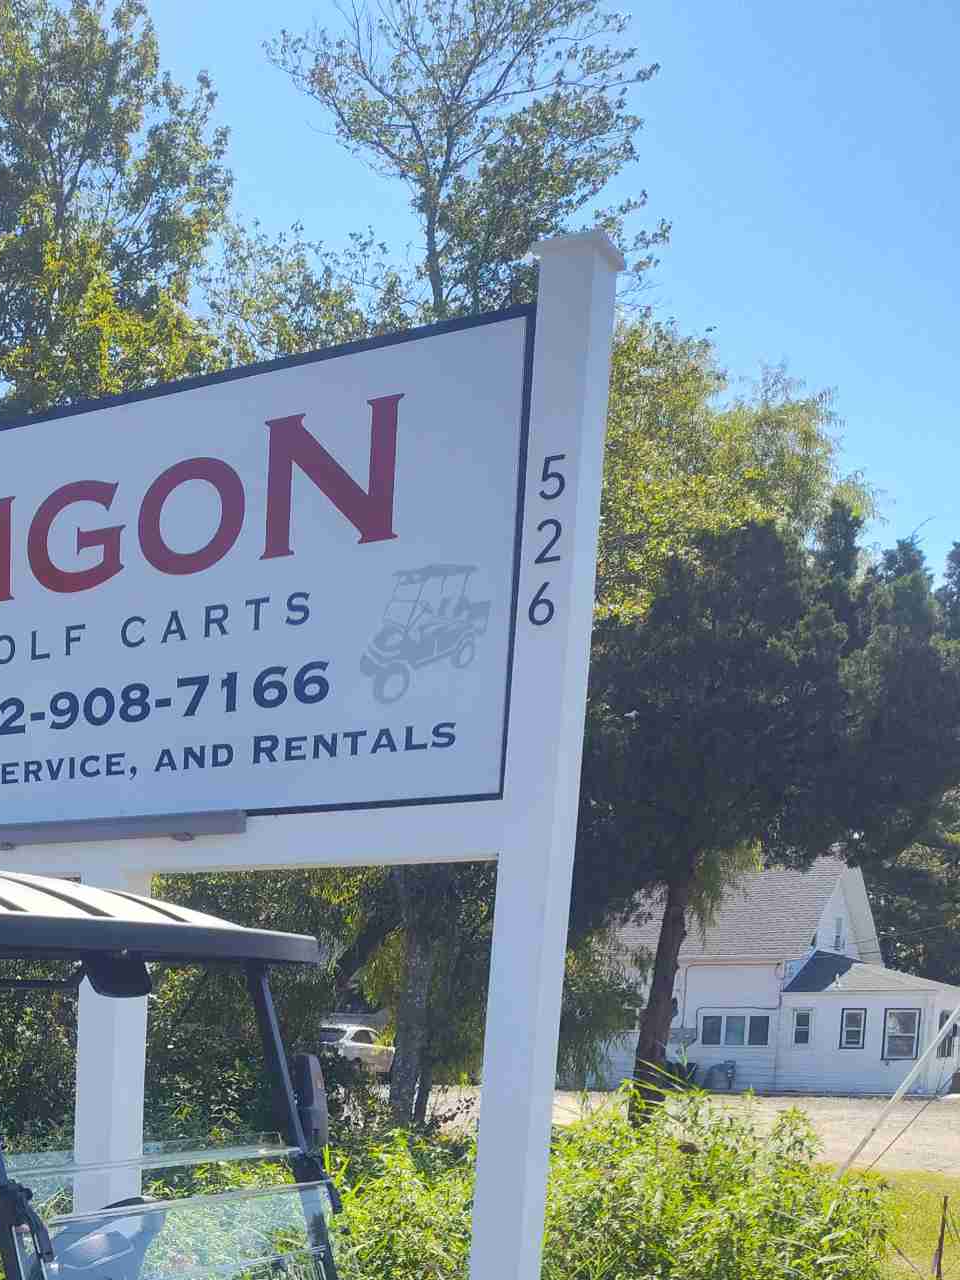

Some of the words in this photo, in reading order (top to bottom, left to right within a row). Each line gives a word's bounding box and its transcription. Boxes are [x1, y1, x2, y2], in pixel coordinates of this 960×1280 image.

[120, 591, 312, 649] CARTS
[154, 742, 235, 772] AND
[251, 722, 457, 765] RENTALS
